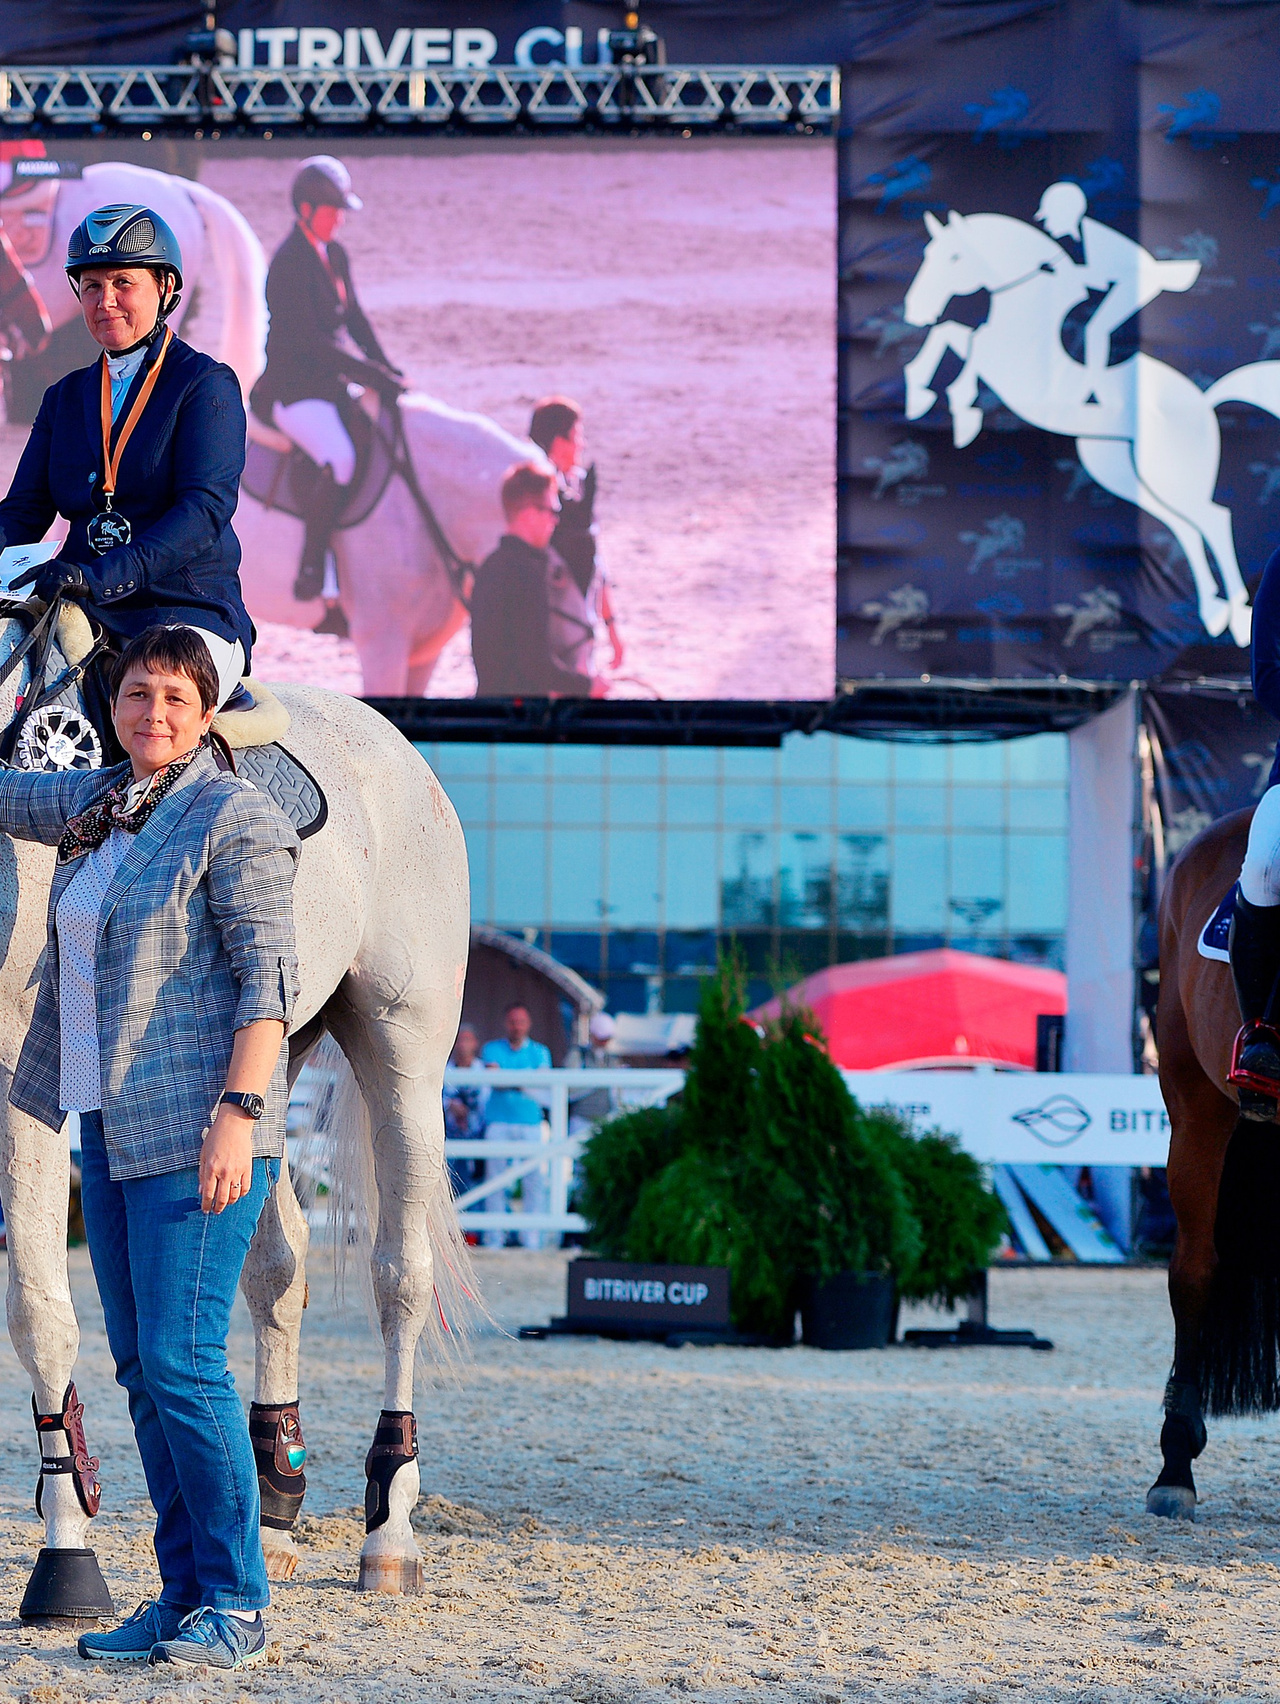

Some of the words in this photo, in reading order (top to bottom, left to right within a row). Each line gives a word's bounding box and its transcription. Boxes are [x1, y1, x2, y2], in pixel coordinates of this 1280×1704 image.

[514, 26, 613, 70] CU
[584, 1278, 666, 1303] BITRIVER
[667, 1281, 709, 1306] CUP
